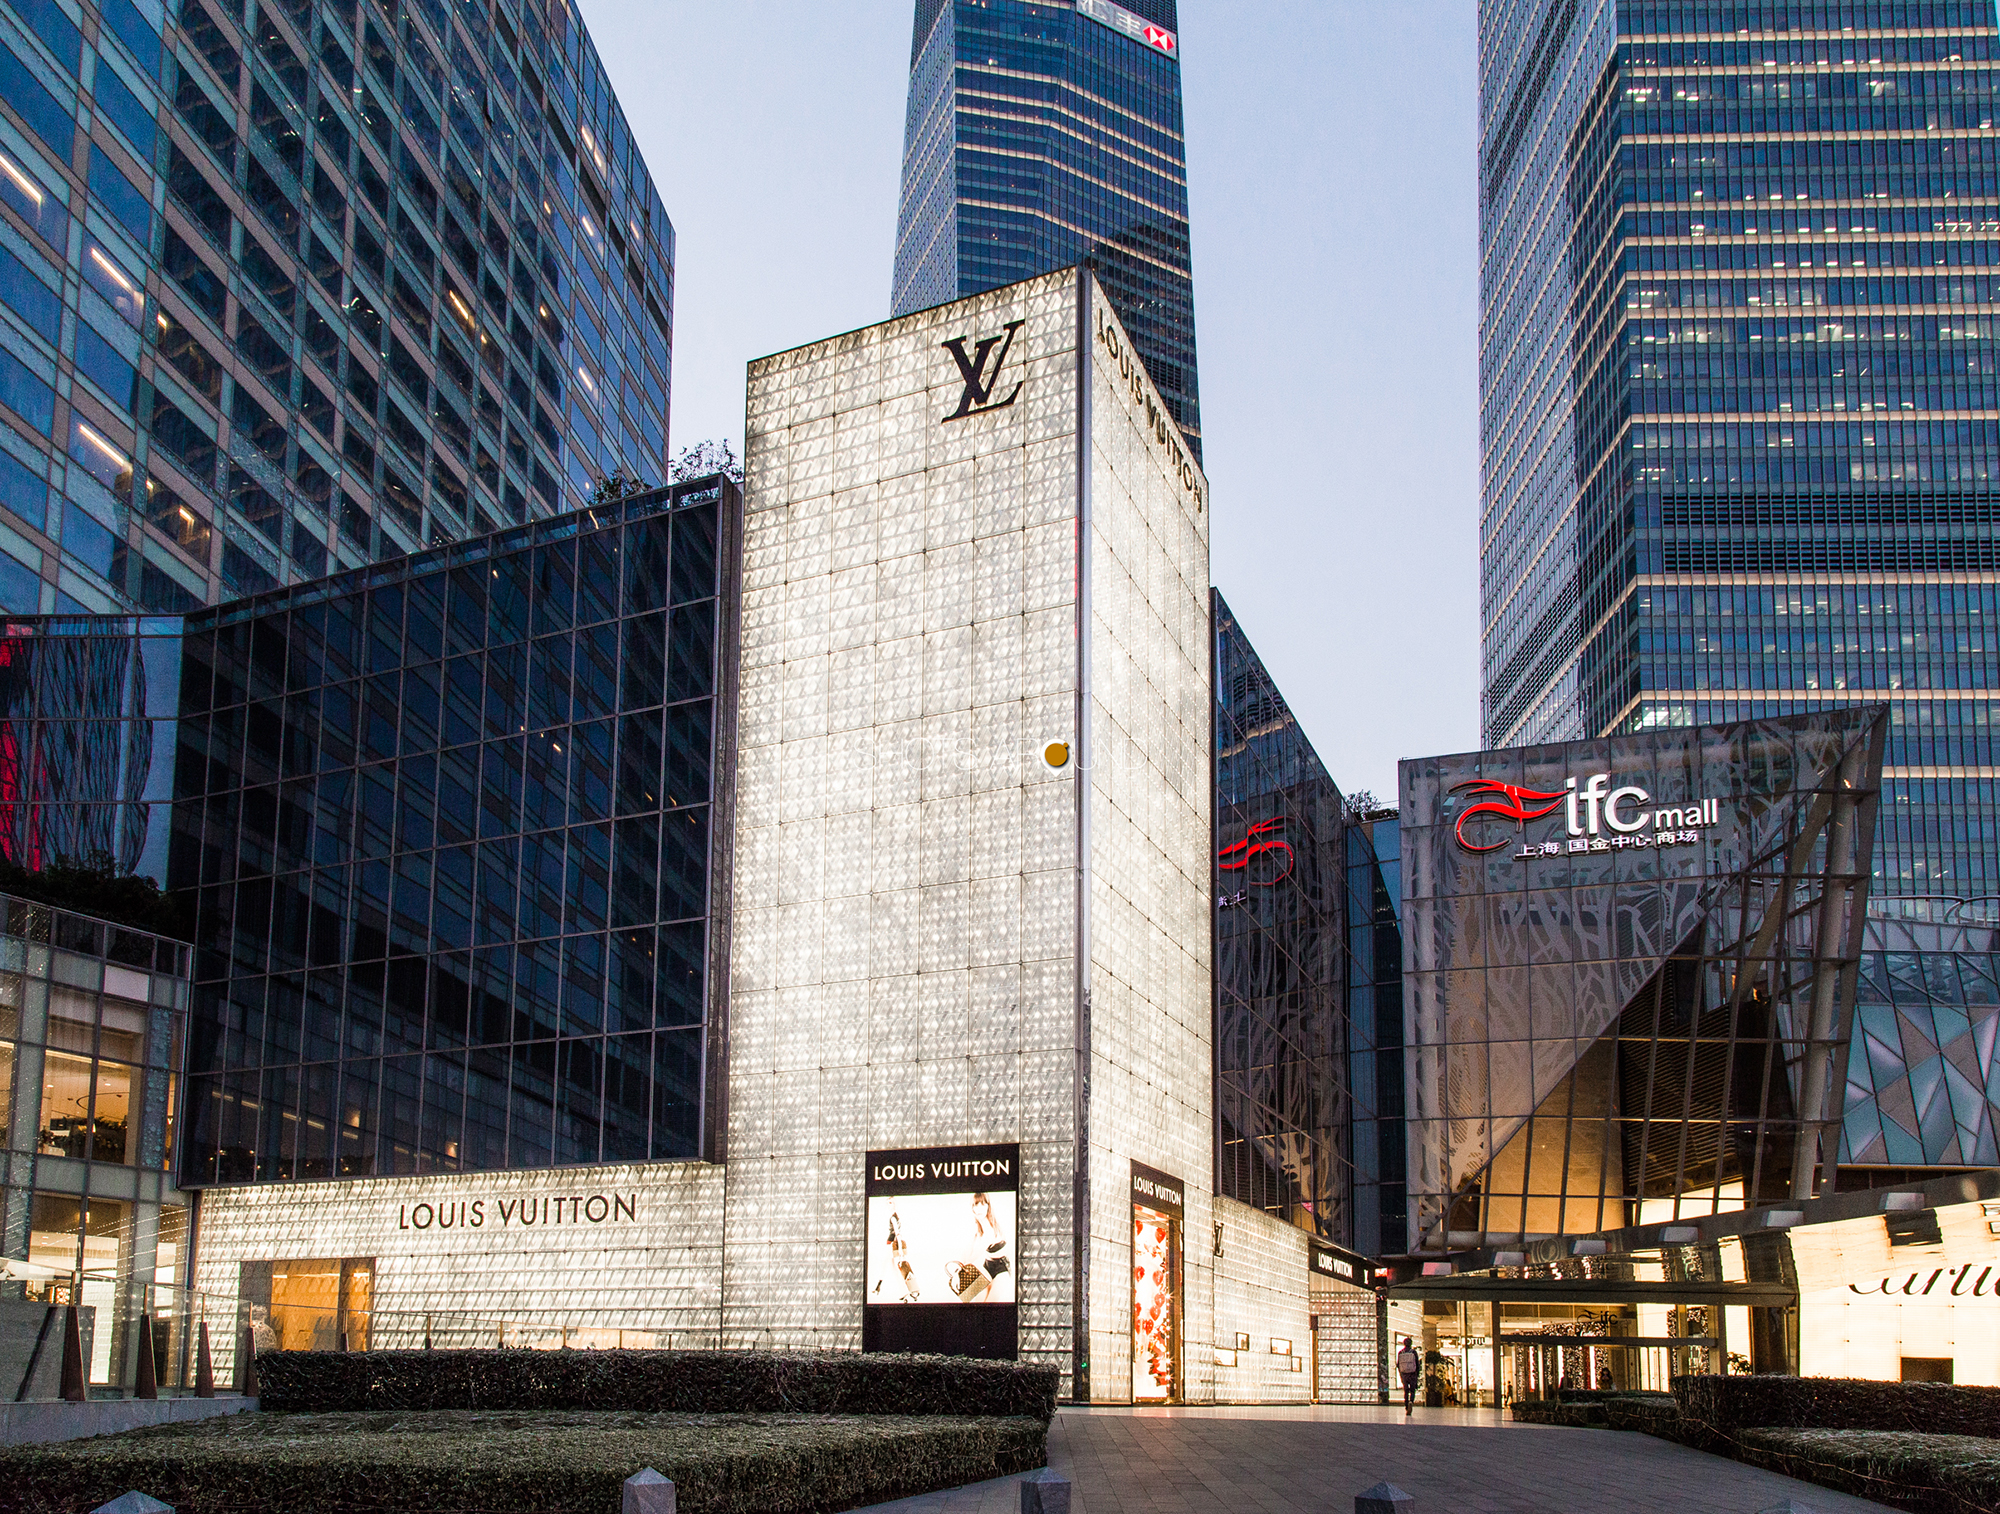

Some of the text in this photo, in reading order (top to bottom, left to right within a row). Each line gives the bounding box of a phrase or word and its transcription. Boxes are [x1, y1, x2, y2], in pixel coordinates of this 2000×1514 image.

[1097, 308, 1202, 513] LOUIS VUITTON
[1566, 773, 1718, 836] ifc mall
[874, 1159, 1010, 1181] LOUIS VUITTON
[1134, 1175, 1182, 1207] LOUIS VUITTON
[399, 1192, 637, 1230] LOUIS VUITTON
[1318, 1252, 1333, 1272] LOUIS
[1332, 1257, 1353, 1279] VUITTON
